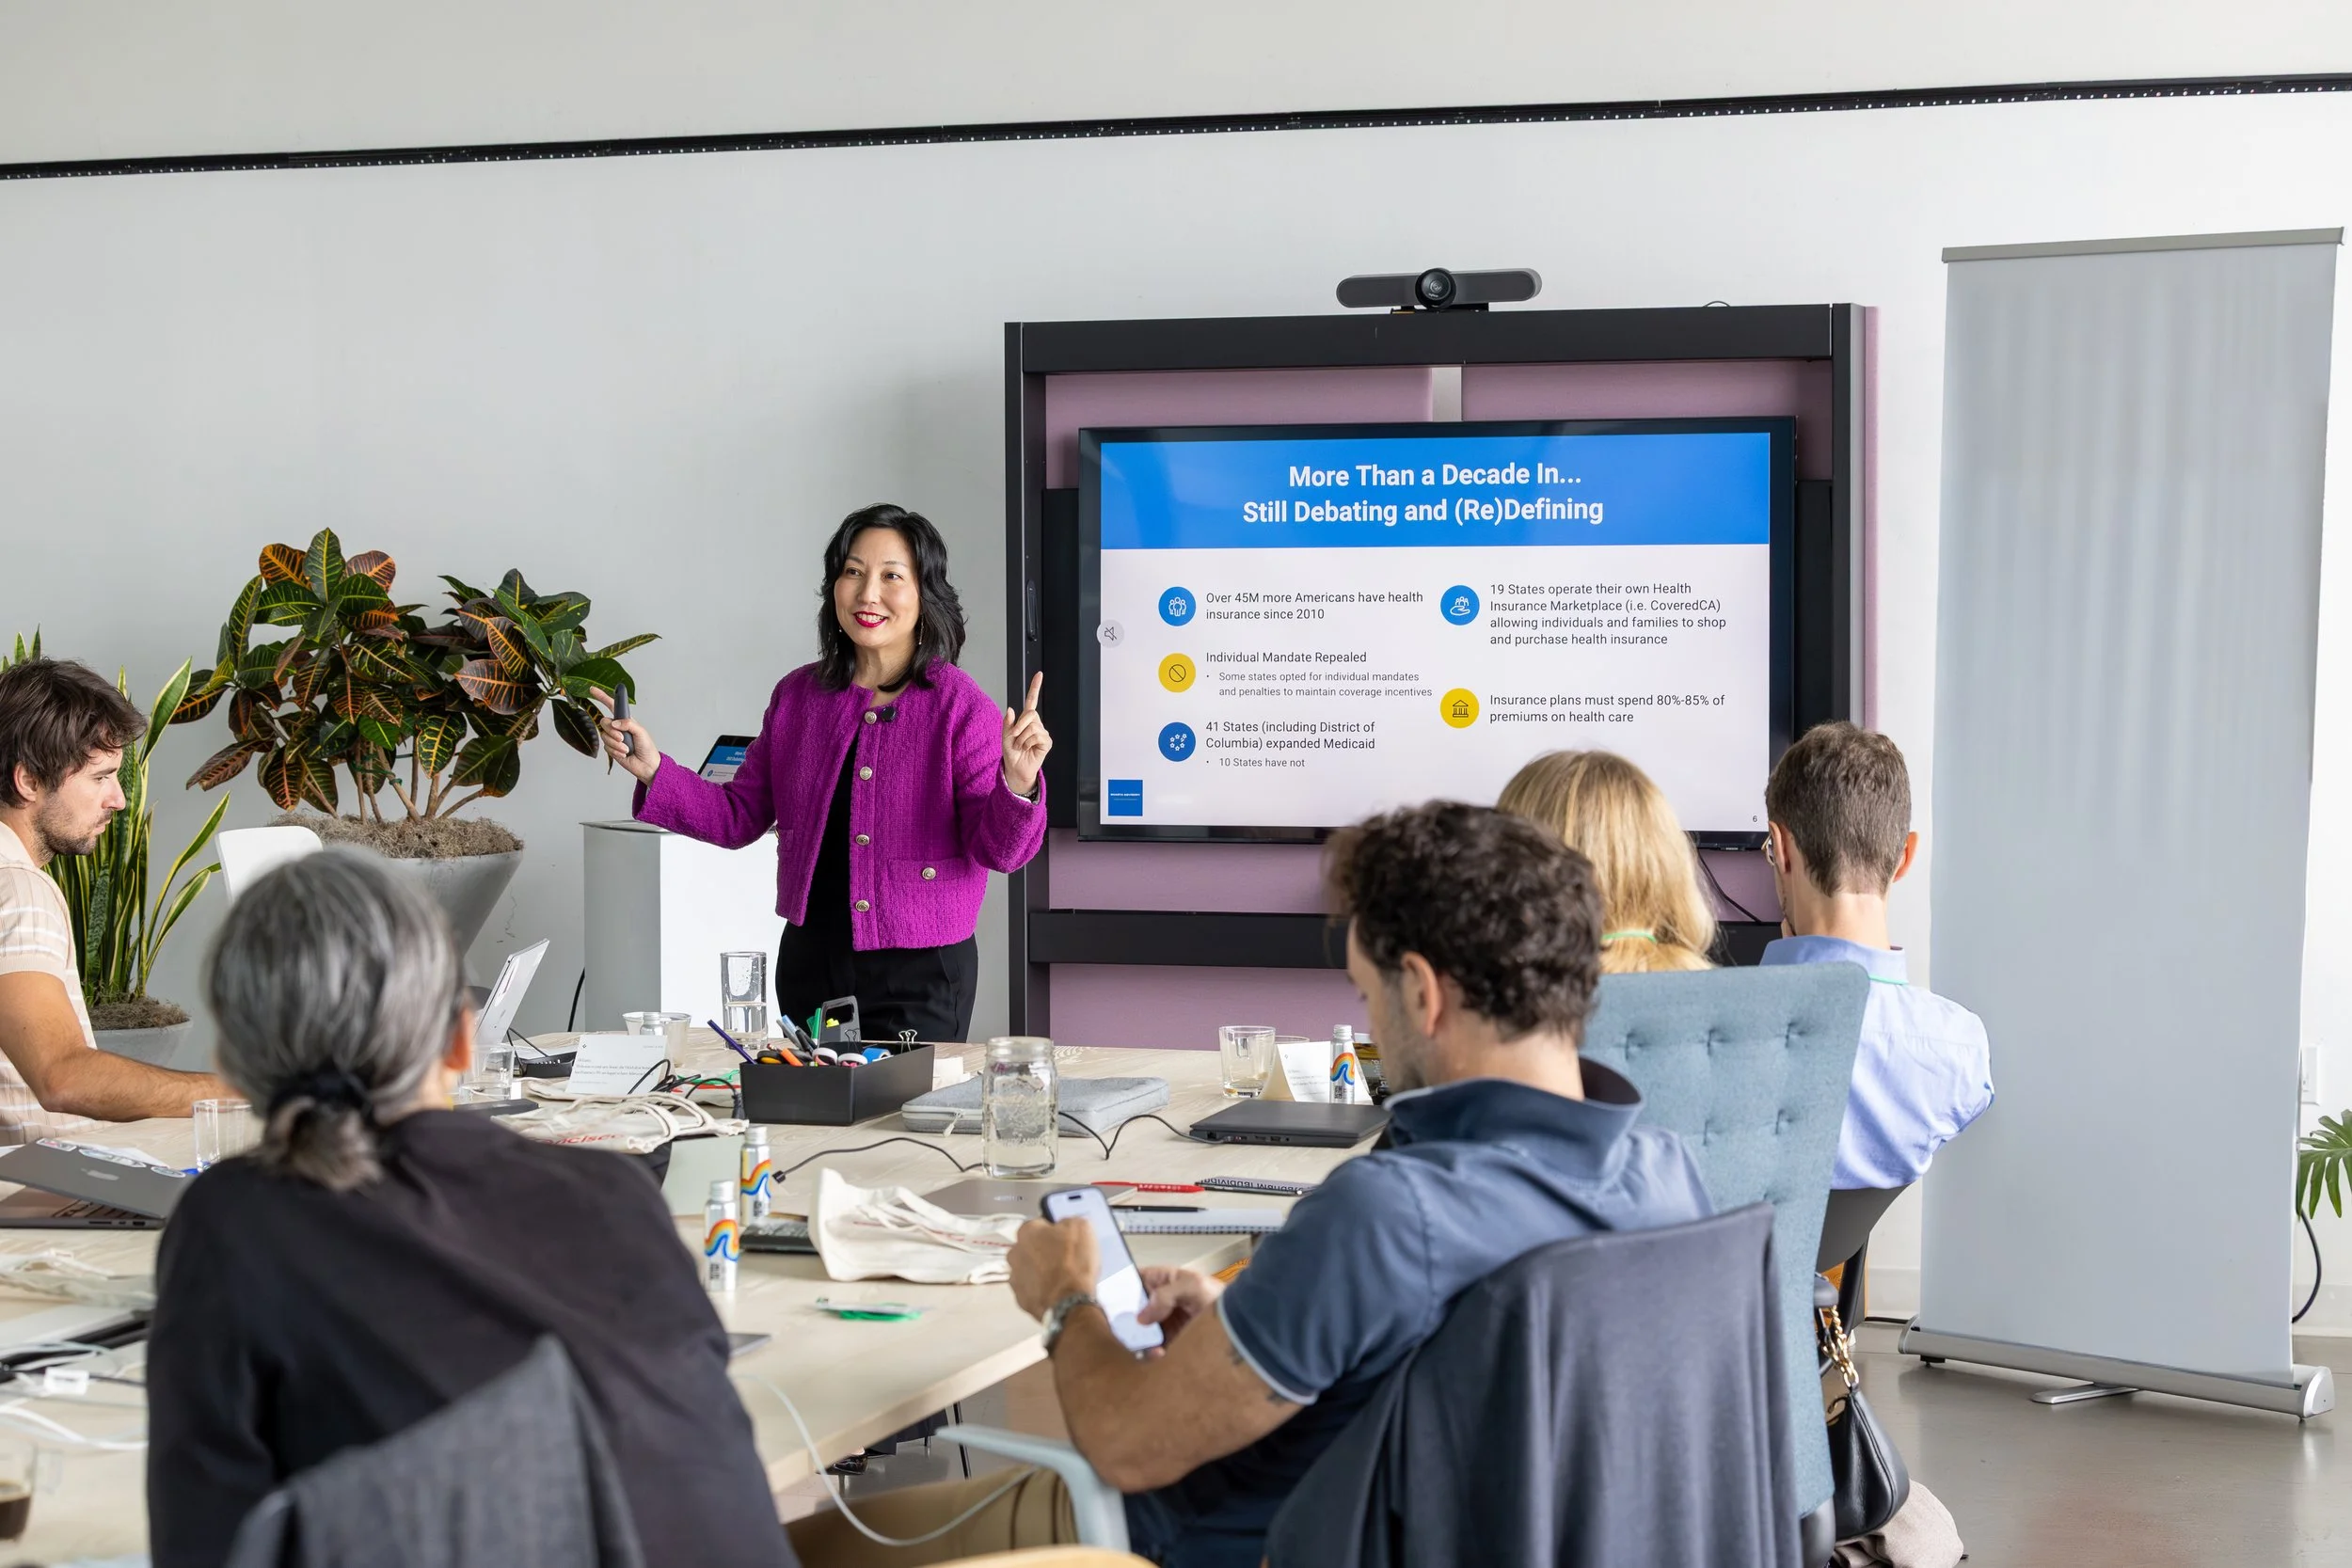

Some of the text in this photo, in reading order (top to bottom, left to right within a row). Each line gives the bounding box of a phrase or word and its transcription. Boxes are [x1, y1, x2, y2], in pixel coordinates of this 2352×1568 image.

[1289, 462, 1581, 487] More Than a Decade In...
[1243, 497, 1603, 527] Still Debating and (Re)Defining
[1490, 582, 1692, 597] 19 States operate their own Health
[1205, 591, 1423, 604] Over 45M more Americans have health
[1490, 598, 1721, 614] Insurance Marketplace (i.e. CoveredCA)
[1206, 608, 1325, 620] insurance since 2010
[1489, 616, 1727, 631] allowing individuals and families to shop
[1489, 633, 1668, 647] and purchase health insurance
[1206, 651, 1367, 666] Individual Mandate Repealed
[1218, 671, 1420, 684] Some states opted for individual mandates
[1218, 686, 1433, 699] and penalties to maintain coverage incentives
[1489, 693, 1726, 708] Insurance plans must spend 80%-85% of
[1489, 710, 1634, 724] premiums on health care
[1205, 720, 1375, 736] 41 States (including District of
[1205, 736, 1375, 752] Columbia) expanded Medicaid
[1218, 757, 1306, 768] 10 States have not
[1751, 814, 1759, 824] 6
